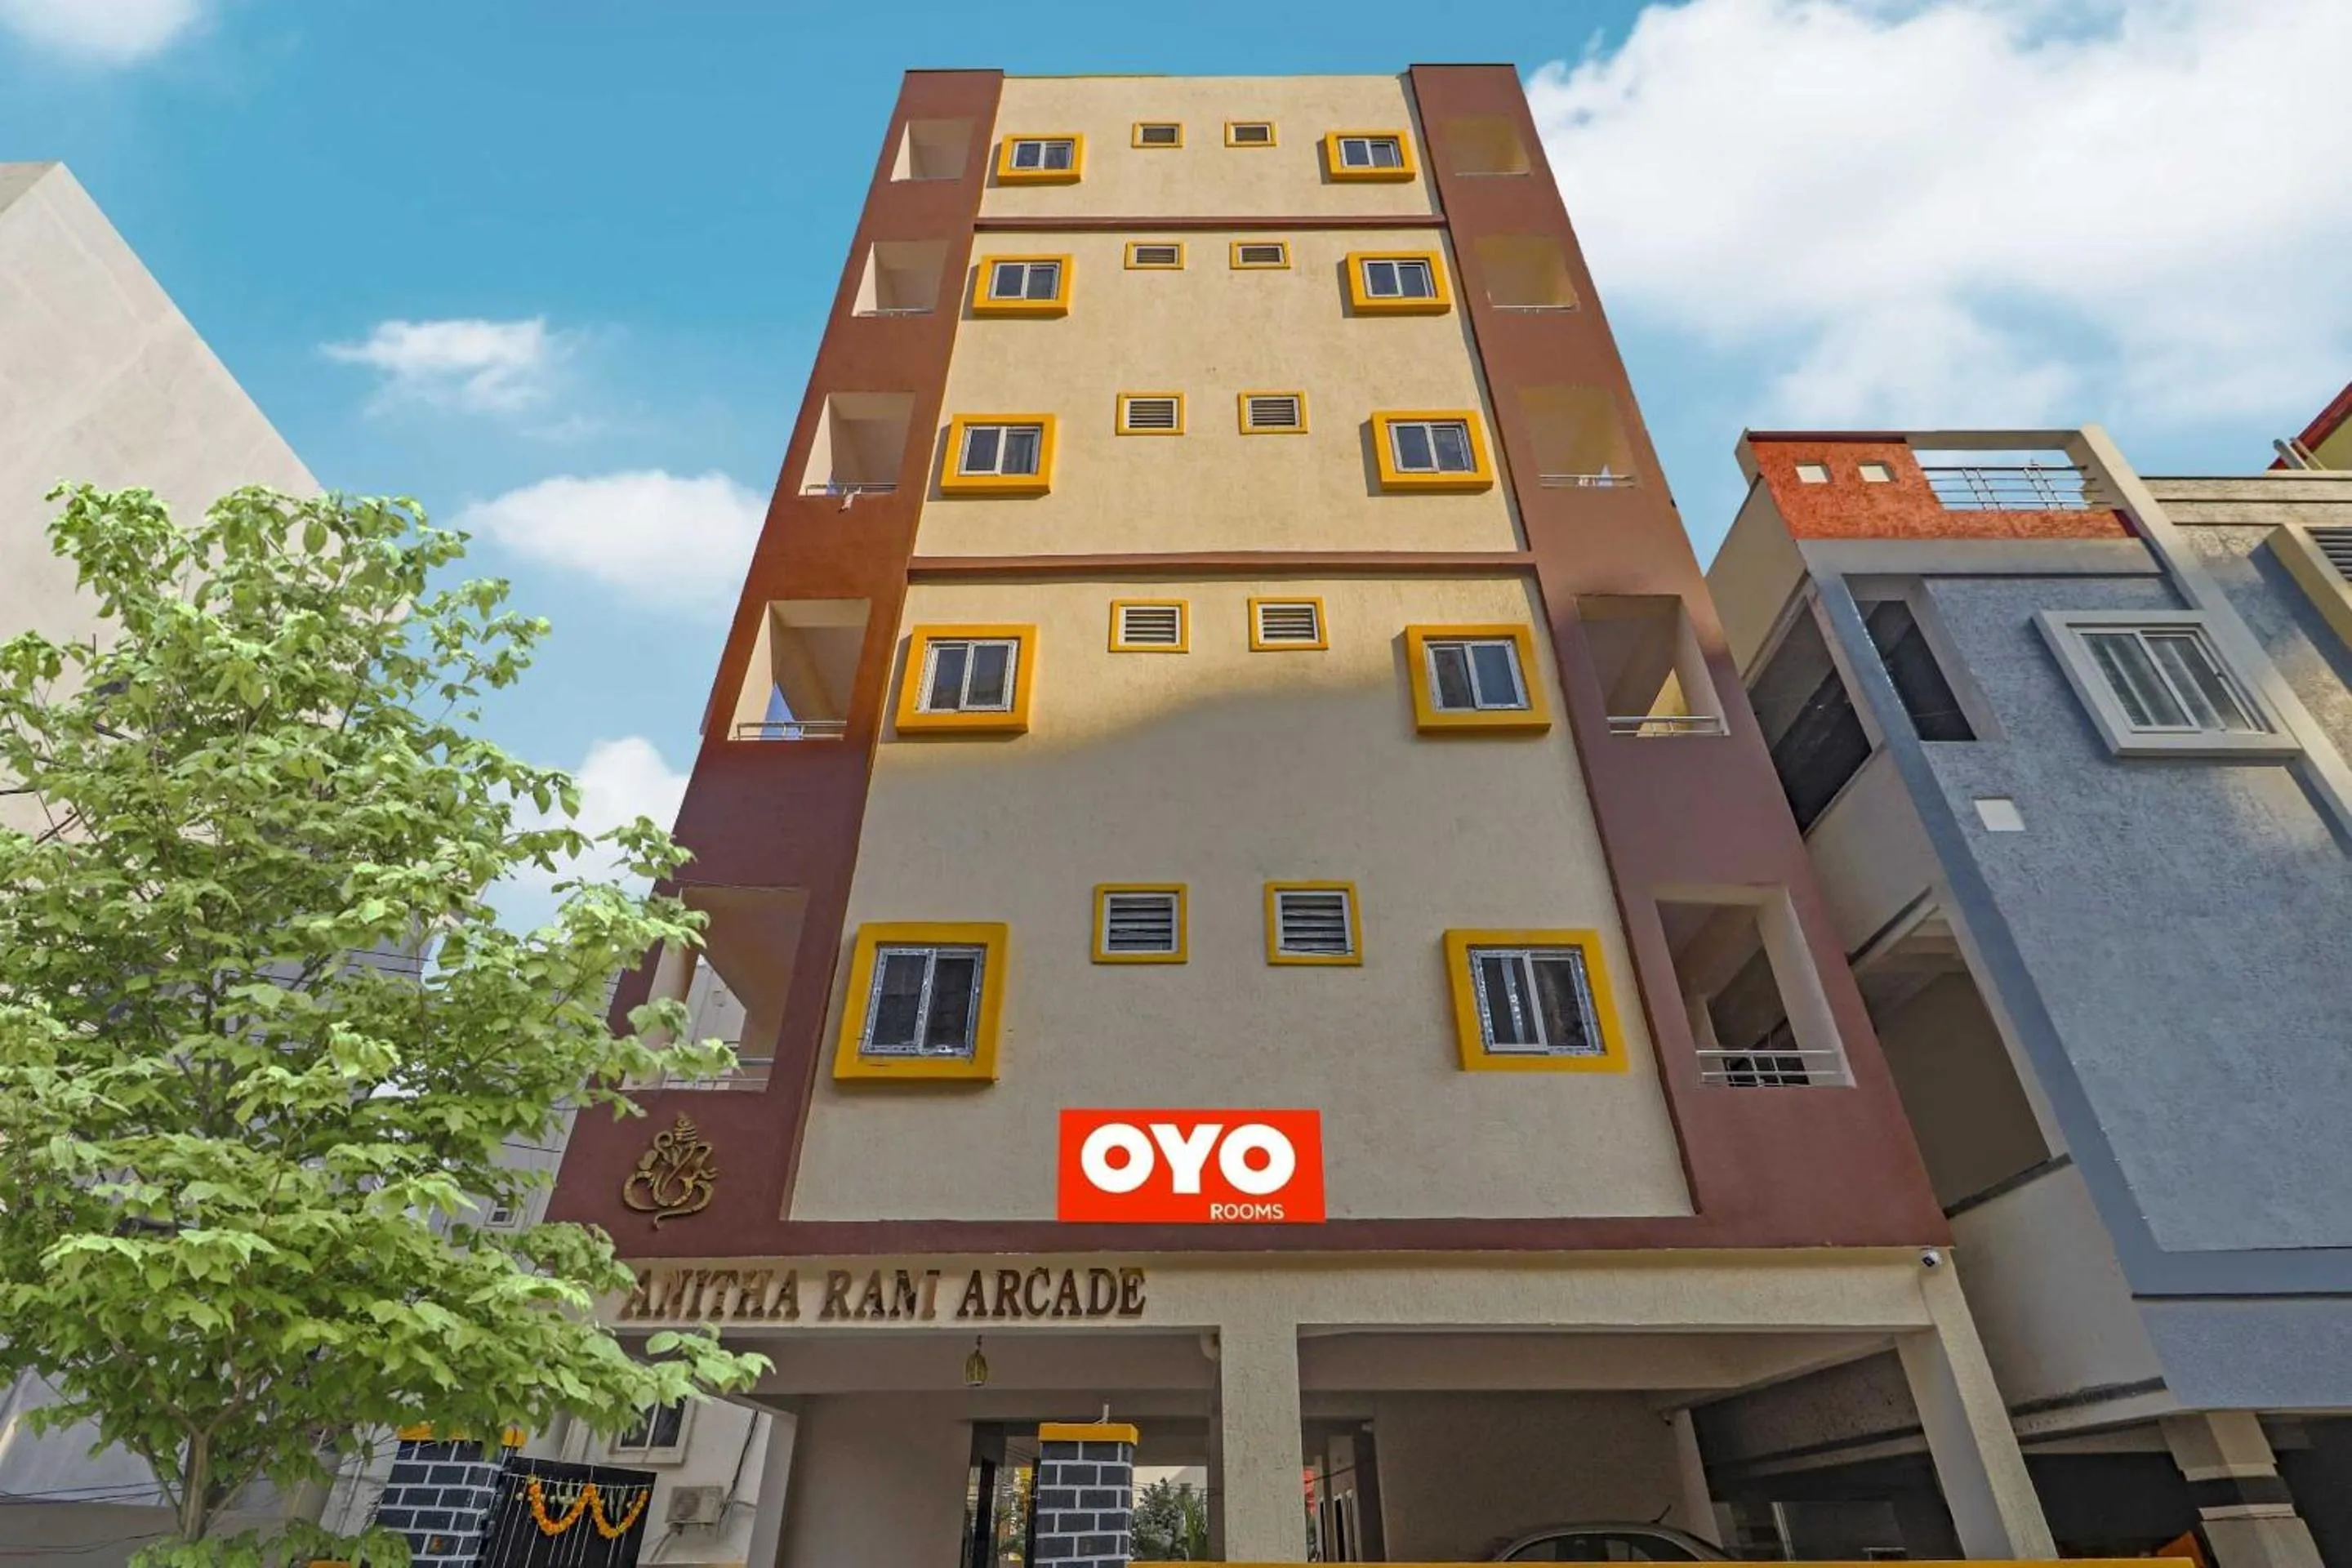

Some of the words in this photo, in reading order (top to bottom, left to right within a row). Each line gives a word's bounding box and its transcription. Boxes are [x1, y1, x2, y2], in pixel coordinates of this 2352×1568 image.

[1080, 1122, 1296, 1196] OYO
[1209, 1203, 1285, 1219] ROOMS
[617, 1268, 800, 1320] ANITHA
[818, 1268, 940, 1320] RANI
[956, 1267, 1146, 1317] ARCADE
